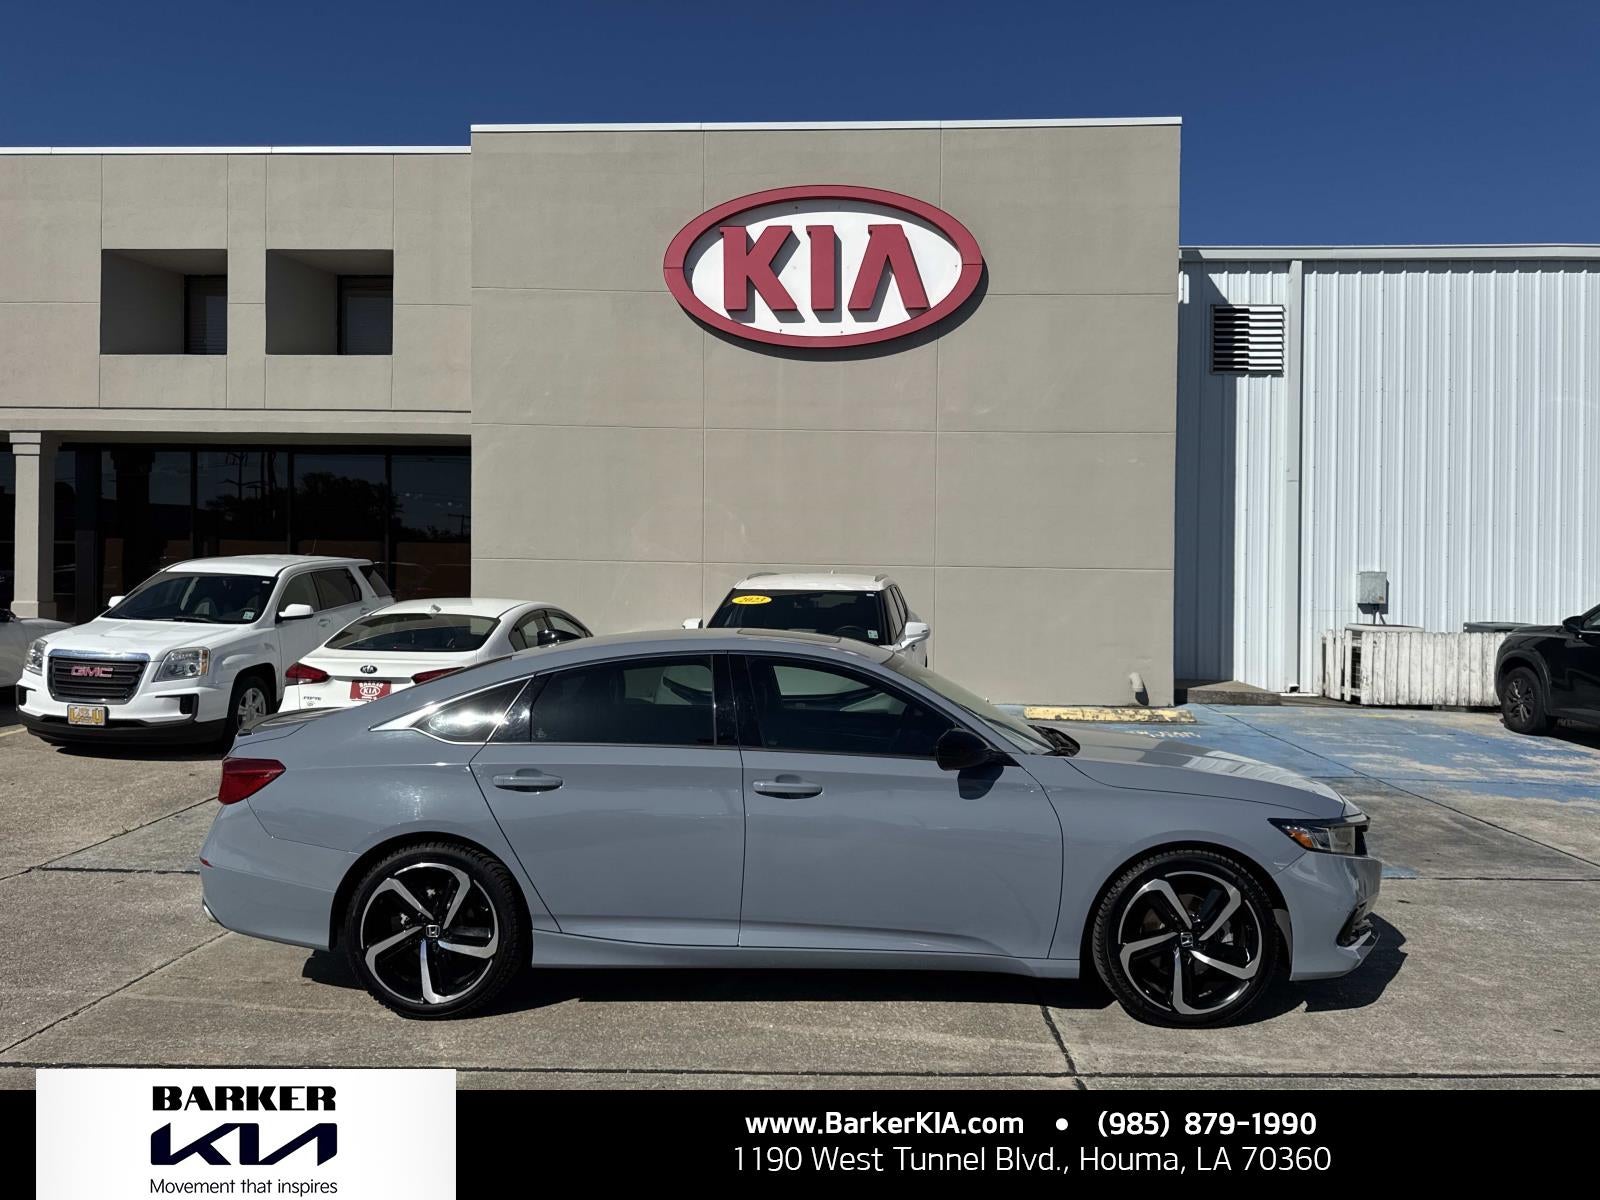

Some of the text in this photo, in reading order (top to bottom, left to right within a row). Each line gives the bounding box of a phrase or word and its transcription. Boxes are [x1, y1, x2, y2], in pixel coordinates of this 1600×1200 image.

[719, 223, 931, 311] KIA
[71, 666, 113, 678] GMC
[363, 687, 378, 695] KIA
